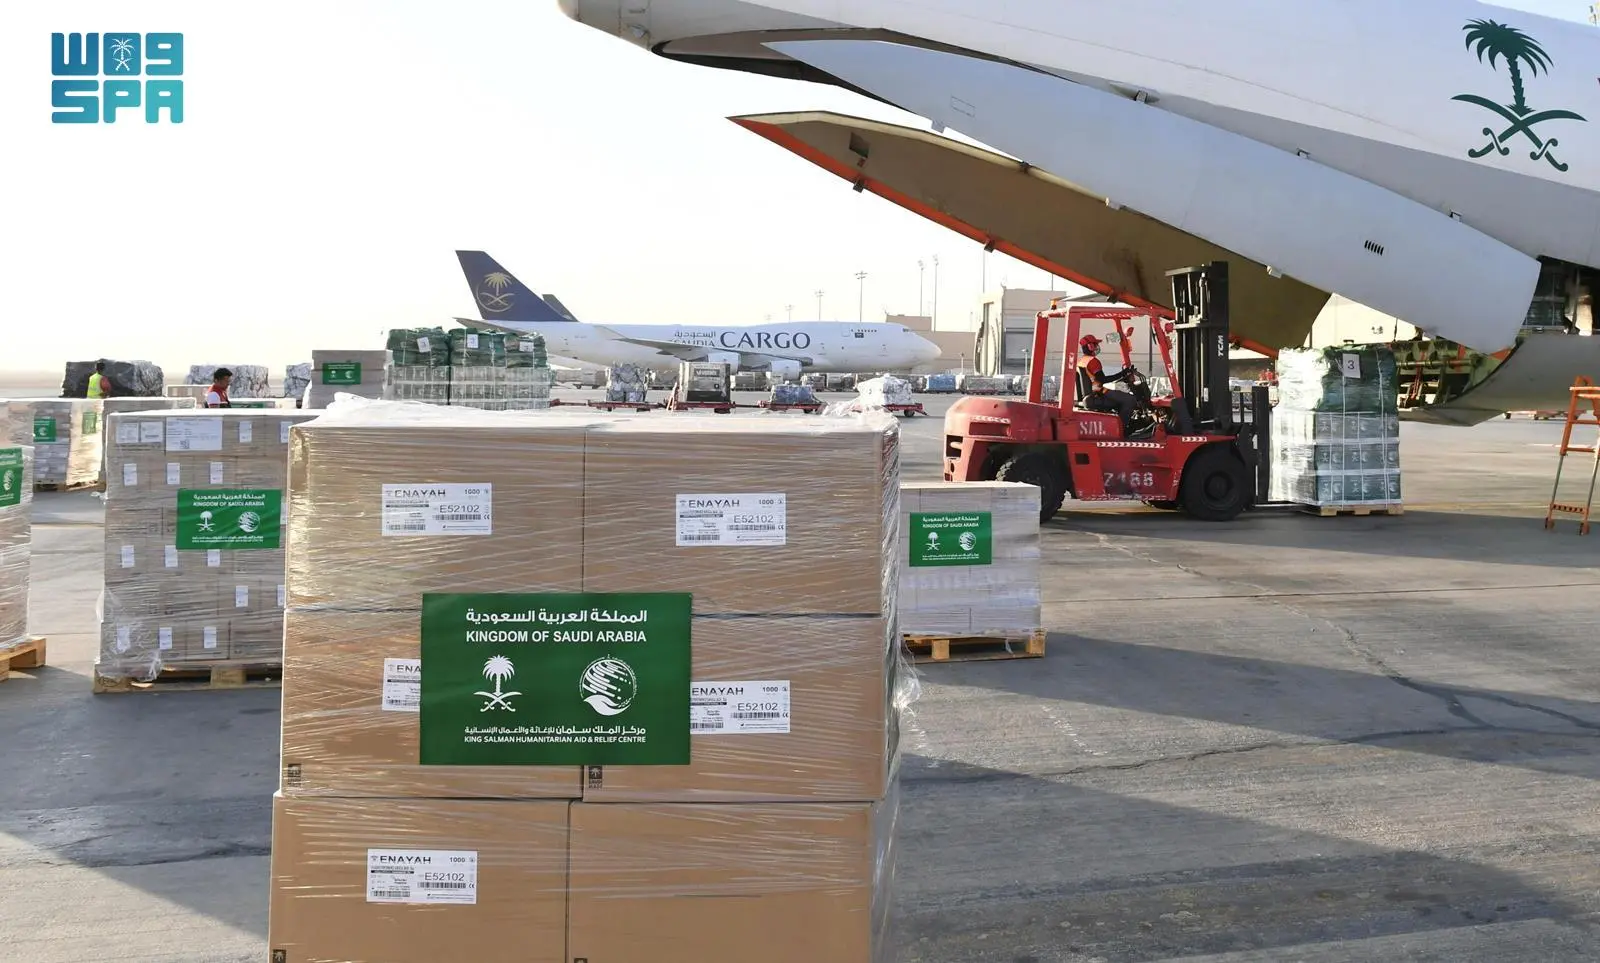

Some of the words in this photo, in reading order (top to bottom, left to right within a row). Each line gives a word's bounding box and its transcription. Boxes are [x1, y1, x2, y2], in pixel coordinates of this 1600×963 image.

[720, 331, 811, 349] CARGO
[1348, 360, 1354, 370] 3
[395, 489, 445, 498] ENAYAH
[689, 500, 740, 508] ENAYAH
[440, 505, 479, 513] E52102
[734, 515, 773, 523] E52102
[466, 608, 535, 625] السعودية
[538, 608, 587, 625] العربية
[590, 608, 647, 623] المملكة
[466, 631, 528, 642] KINGDOM
[532, 631, 550, 642] OF
[554, 631, 593, 642] SAUDI
[596, 631, 646, 642] ARABIA
[738, 703, 778, 711] E52102
[465, 726, 498, 734] الإنسانية
[556, 725, 591, 734] سلمان
[593, 725, 620, 734] الملك
[621, 725, 646, 735] مركز
[380, 856, 431, 864] ENAYAH
[424, 873, 464, 881] E52102
